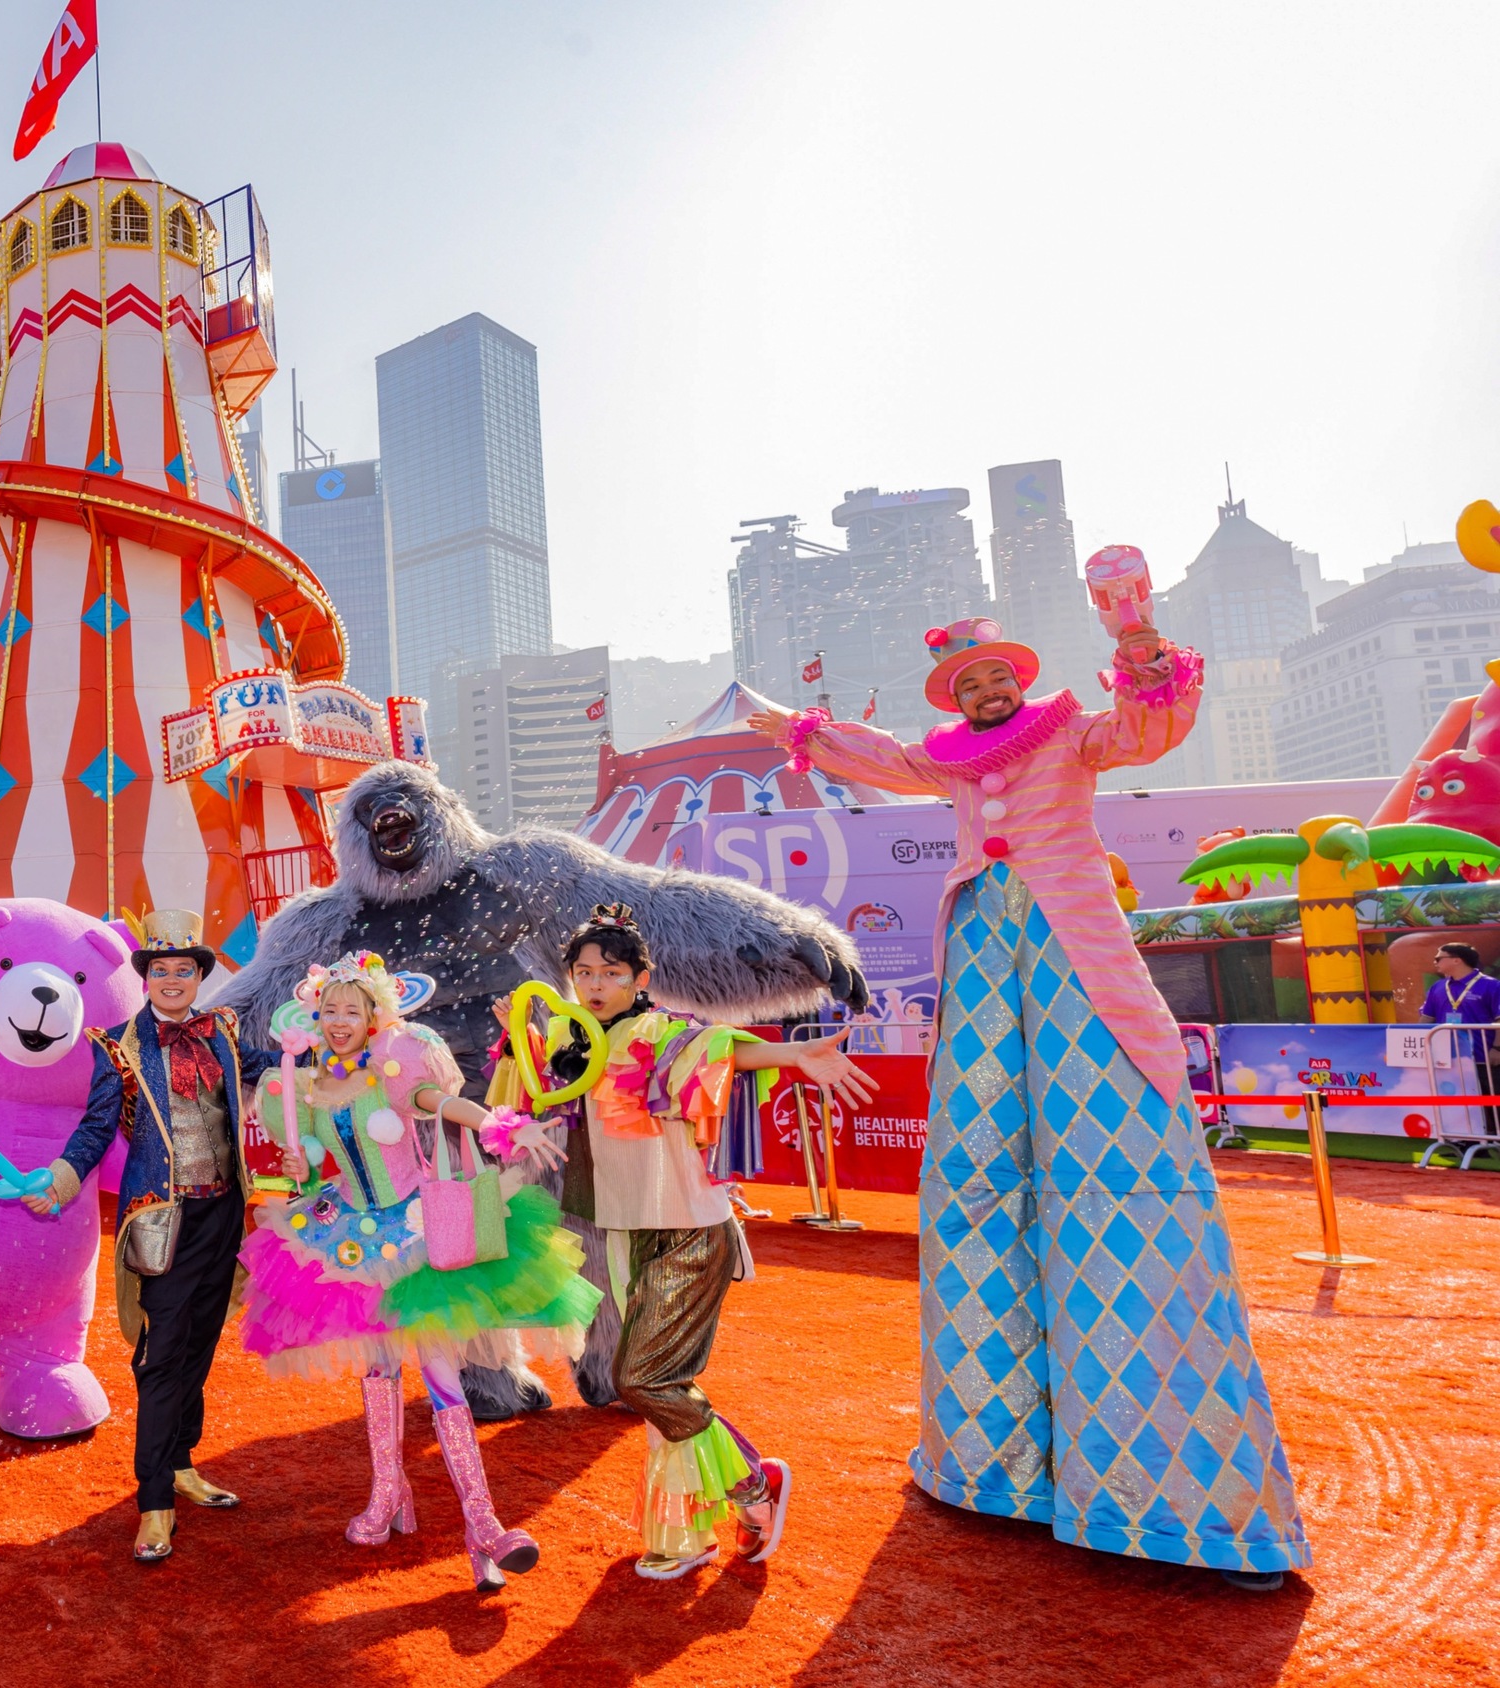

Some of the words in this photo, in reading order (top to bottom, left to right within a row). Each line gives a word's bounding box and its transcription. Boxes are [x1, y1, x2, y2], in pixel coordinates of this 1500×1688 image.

[27, 10, 86, 103] IA
[217, 680, 288, 717] FUN
[247, 709, 266, 718] FOR
[298, 694, 373, 734] HELTER
[181, 721, 196, 730] HAVE
[238, 718, 281, 739] ALL
[176, 724, 207, 750] JOY
[300, 723, 386, 757] SKELTER
[173, 741, 214, 770] RIDE
[921, 841, 957, 851] EXPRE
[1310, 1060, 1329, 1068] AIA
[1297, 1070, 1382, 1088] CARNIVAL
[853, 1116, 928, 1133] HEALTHIER
[244, 1126, 270, 1147] IA
[855, 1132, 906, 1148] BETTER
